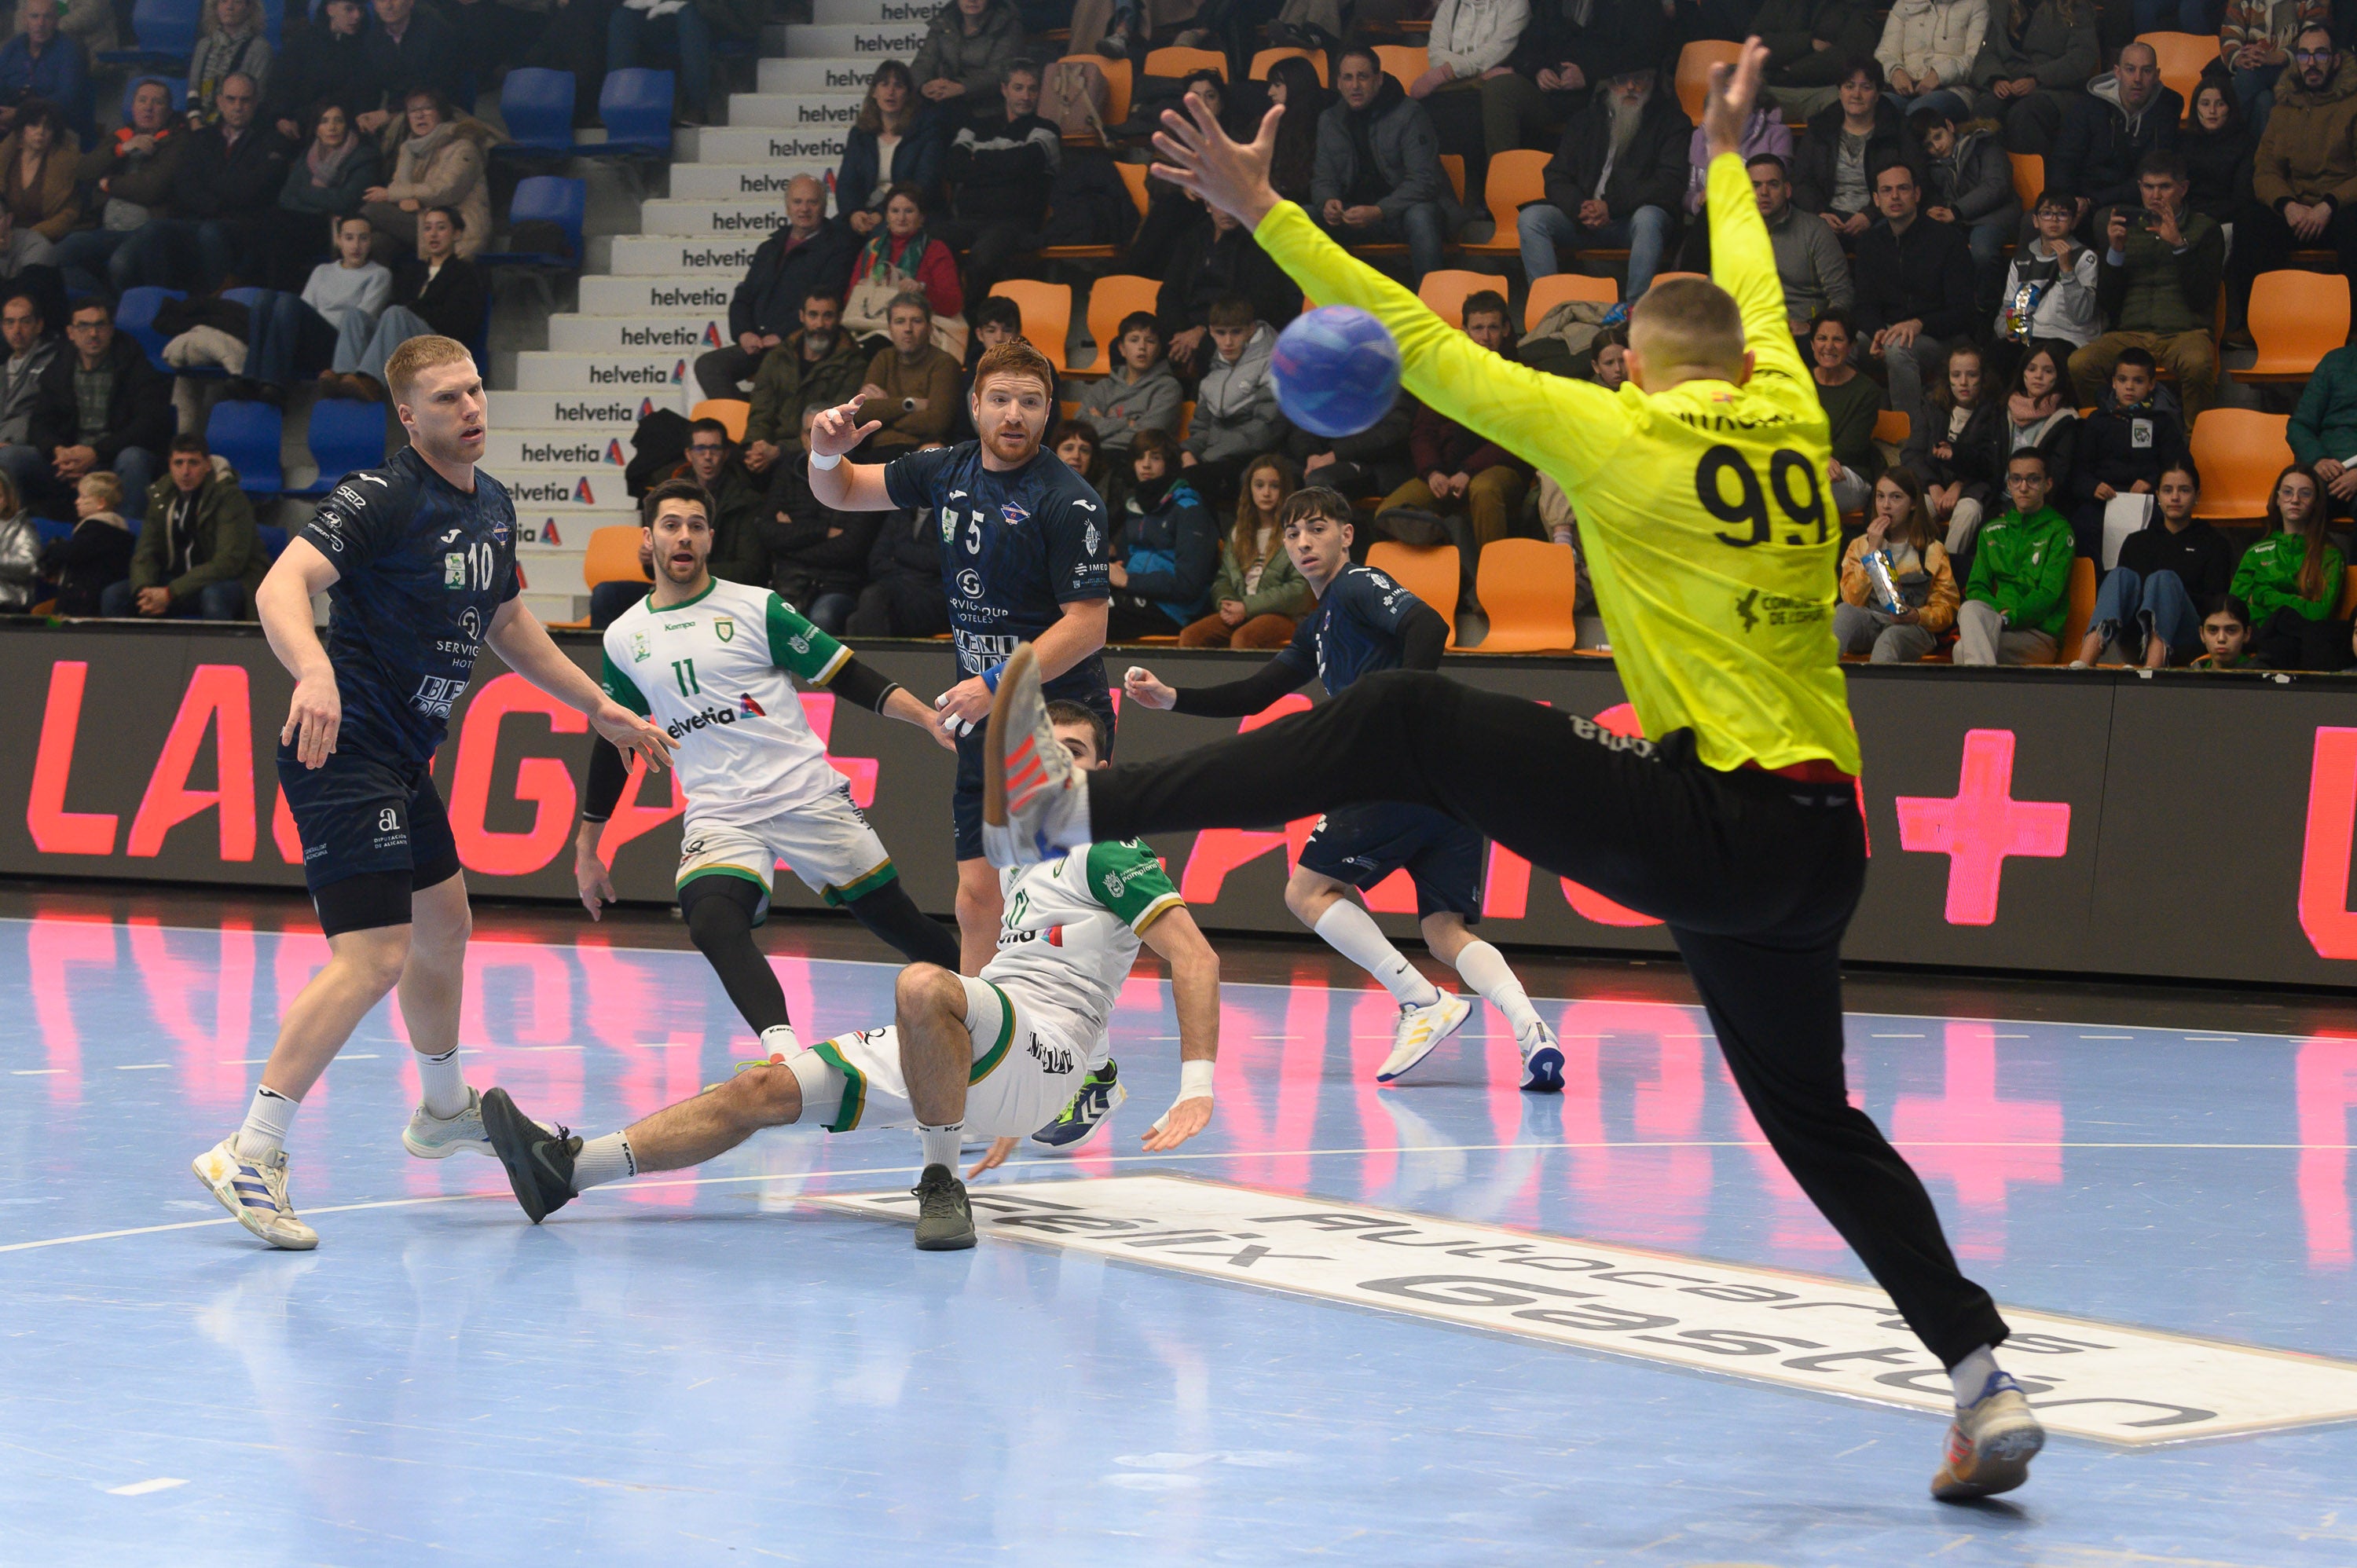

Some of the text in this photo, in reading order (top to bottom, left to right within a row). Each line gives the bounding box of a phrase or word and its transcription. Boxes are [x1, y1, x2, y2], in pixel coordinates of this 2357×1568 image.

[881, 2, 944, 20] helveti
[826, 69, 874, 86] helve
[798, 104, 860, 122] helveti
[769, 137, 845, 156] helvetia
[740, 174, 790, 192] helve
[713, 211, 788, 230] helvetia
[651, 287, 727, 306] helvetia
[621, 327, 698, 346] helvetia
[589, 365, 667, 383] helvetia
[555, 403, 632, 422] helvetia
[522, 442, 599, 462] helvetia
[506, 482, 569, 501] elvetia
[1695, 444, 1827, 548] 99
[966, 510, 985, 555] 5
[467, 542, 493, 591] 10
[671, 658, 701, 698] 11
[668, 706, 736, 740] elvetia
[1121, 863, 1158, 884] Pamplona
[1245, 1212, 2121, 1354] Autocars
